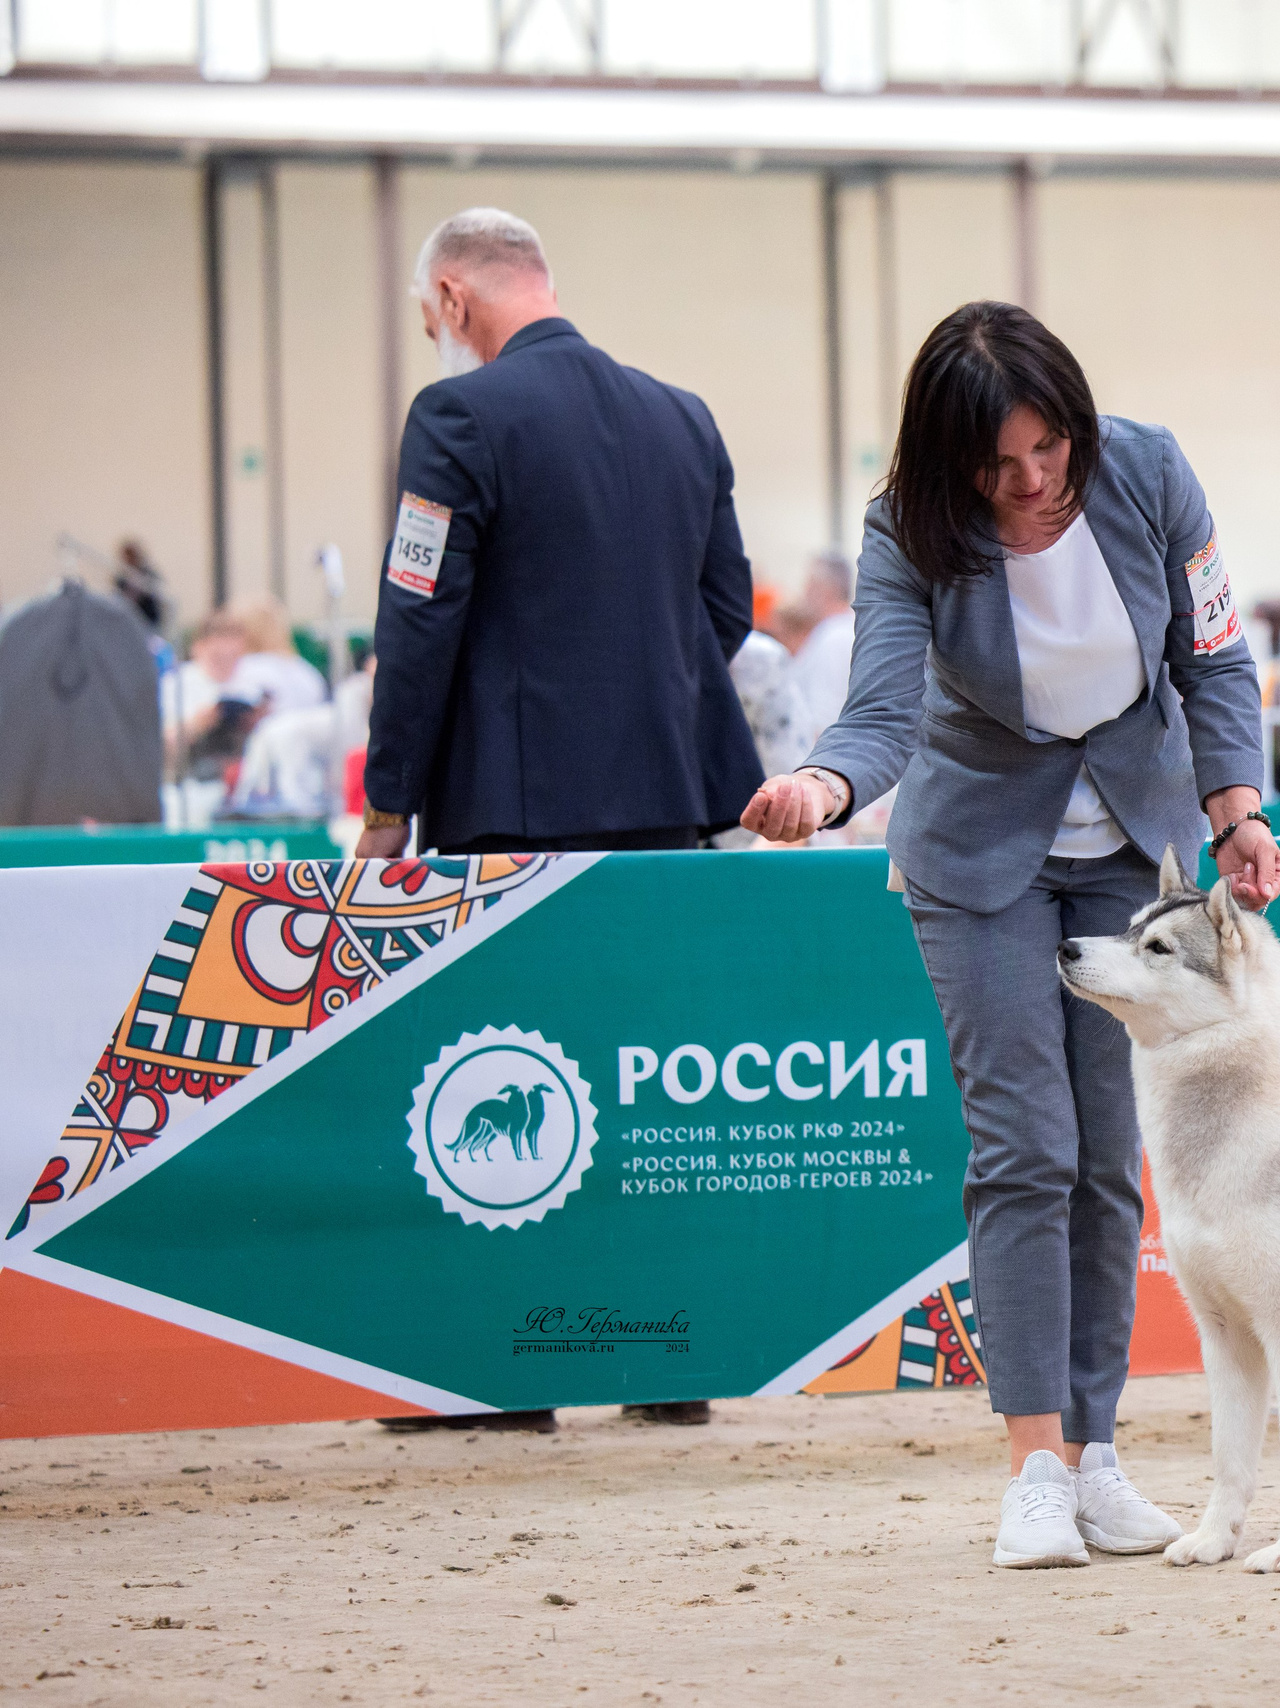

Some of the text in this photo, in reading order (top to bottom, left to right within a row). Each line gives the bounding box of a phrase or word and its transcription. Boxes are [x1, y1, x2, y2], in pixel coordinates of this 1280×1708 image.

[399, 537, 433, 567] 1455
[617, 1038, 928, 1105] РОССИЯ
[729, 1123, 796, 1141] КУБОК
[802, 1122, 844, 1139] РКФ
[850, 1120, 906, 1138] 2024»
[729, 1152, 796, 1170] КУБОК
[803, 1149, 892, 1167] МОСКВЫ
[898, 1148, 912, 1165] &
[621, 1169, 934, 1195] КУБОК ГОРОДОВ-ГЕРОЕВ 2024»
